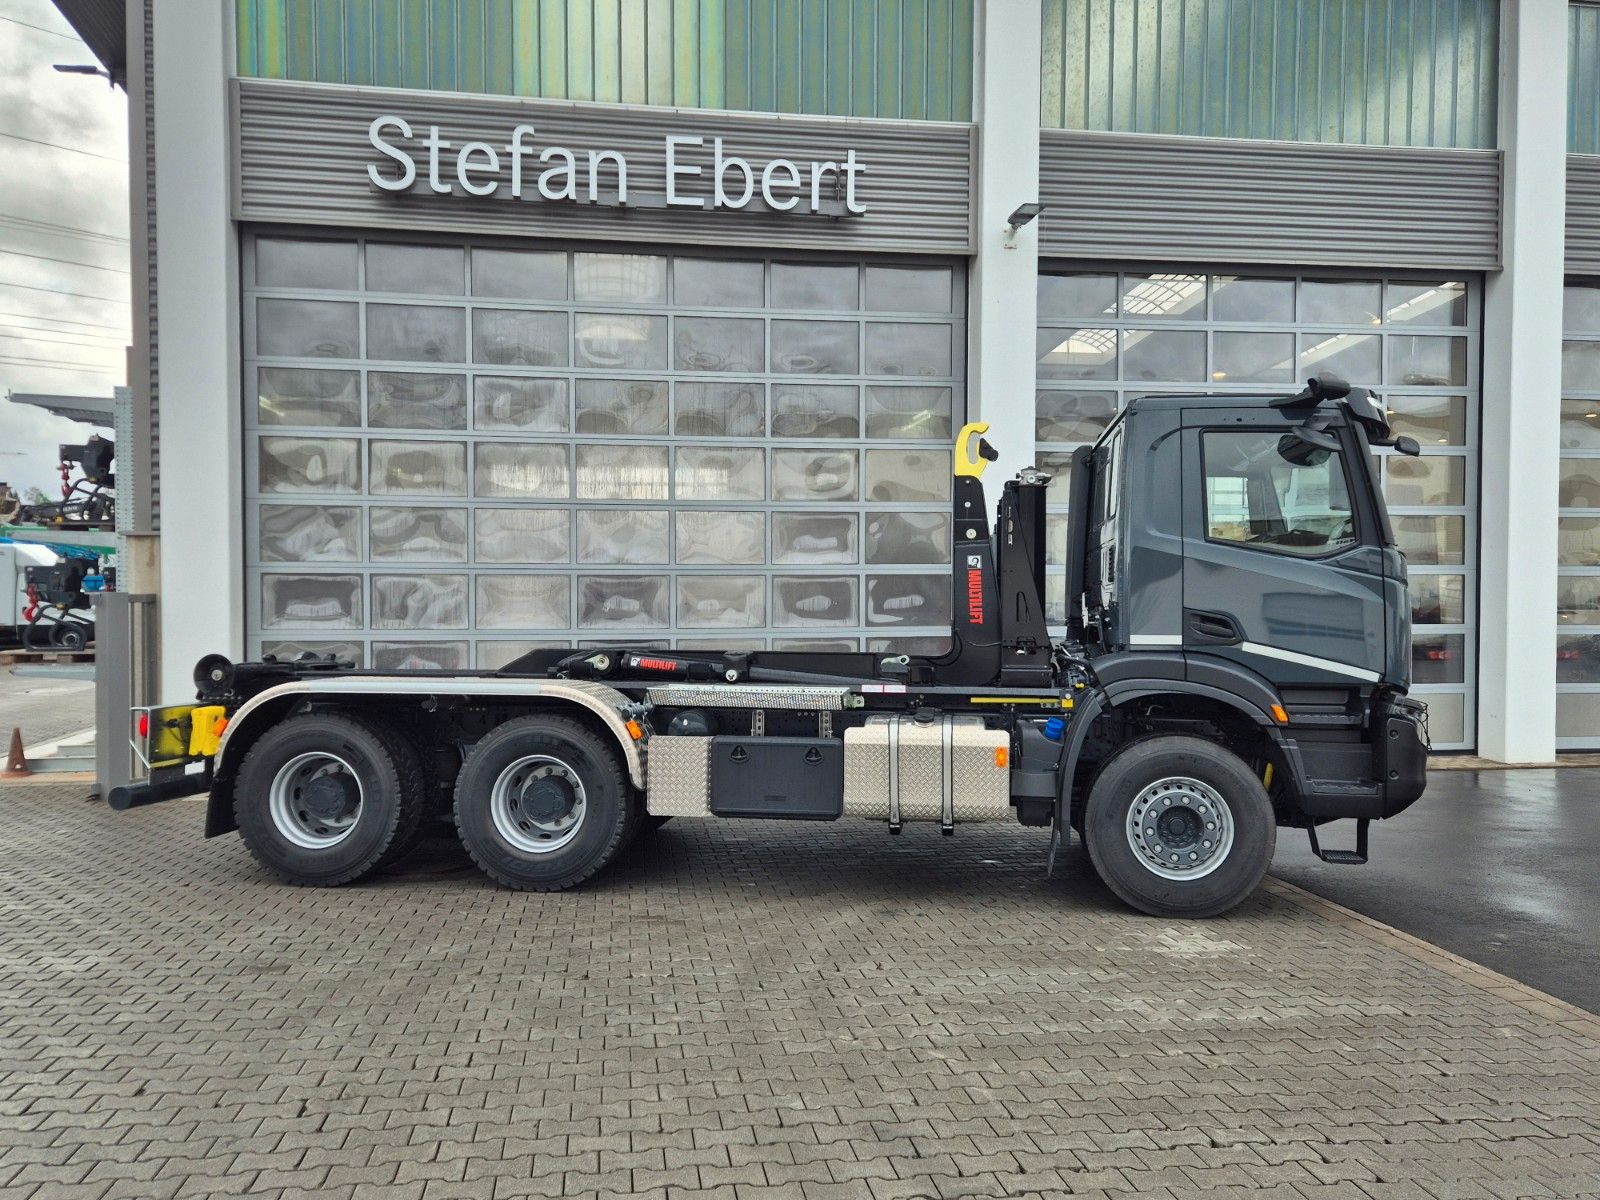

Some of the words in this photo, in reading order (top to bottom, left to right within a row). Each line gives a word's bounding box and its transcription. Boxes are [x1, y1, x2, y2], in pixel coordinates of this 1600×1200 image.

[367, 115, 628, 204] Stefan
[665, 135, 866, 214] Ebert
[968, 569, 983, 624] MULTILIFT
[640, 658, 677, 671] MULTILIFT
